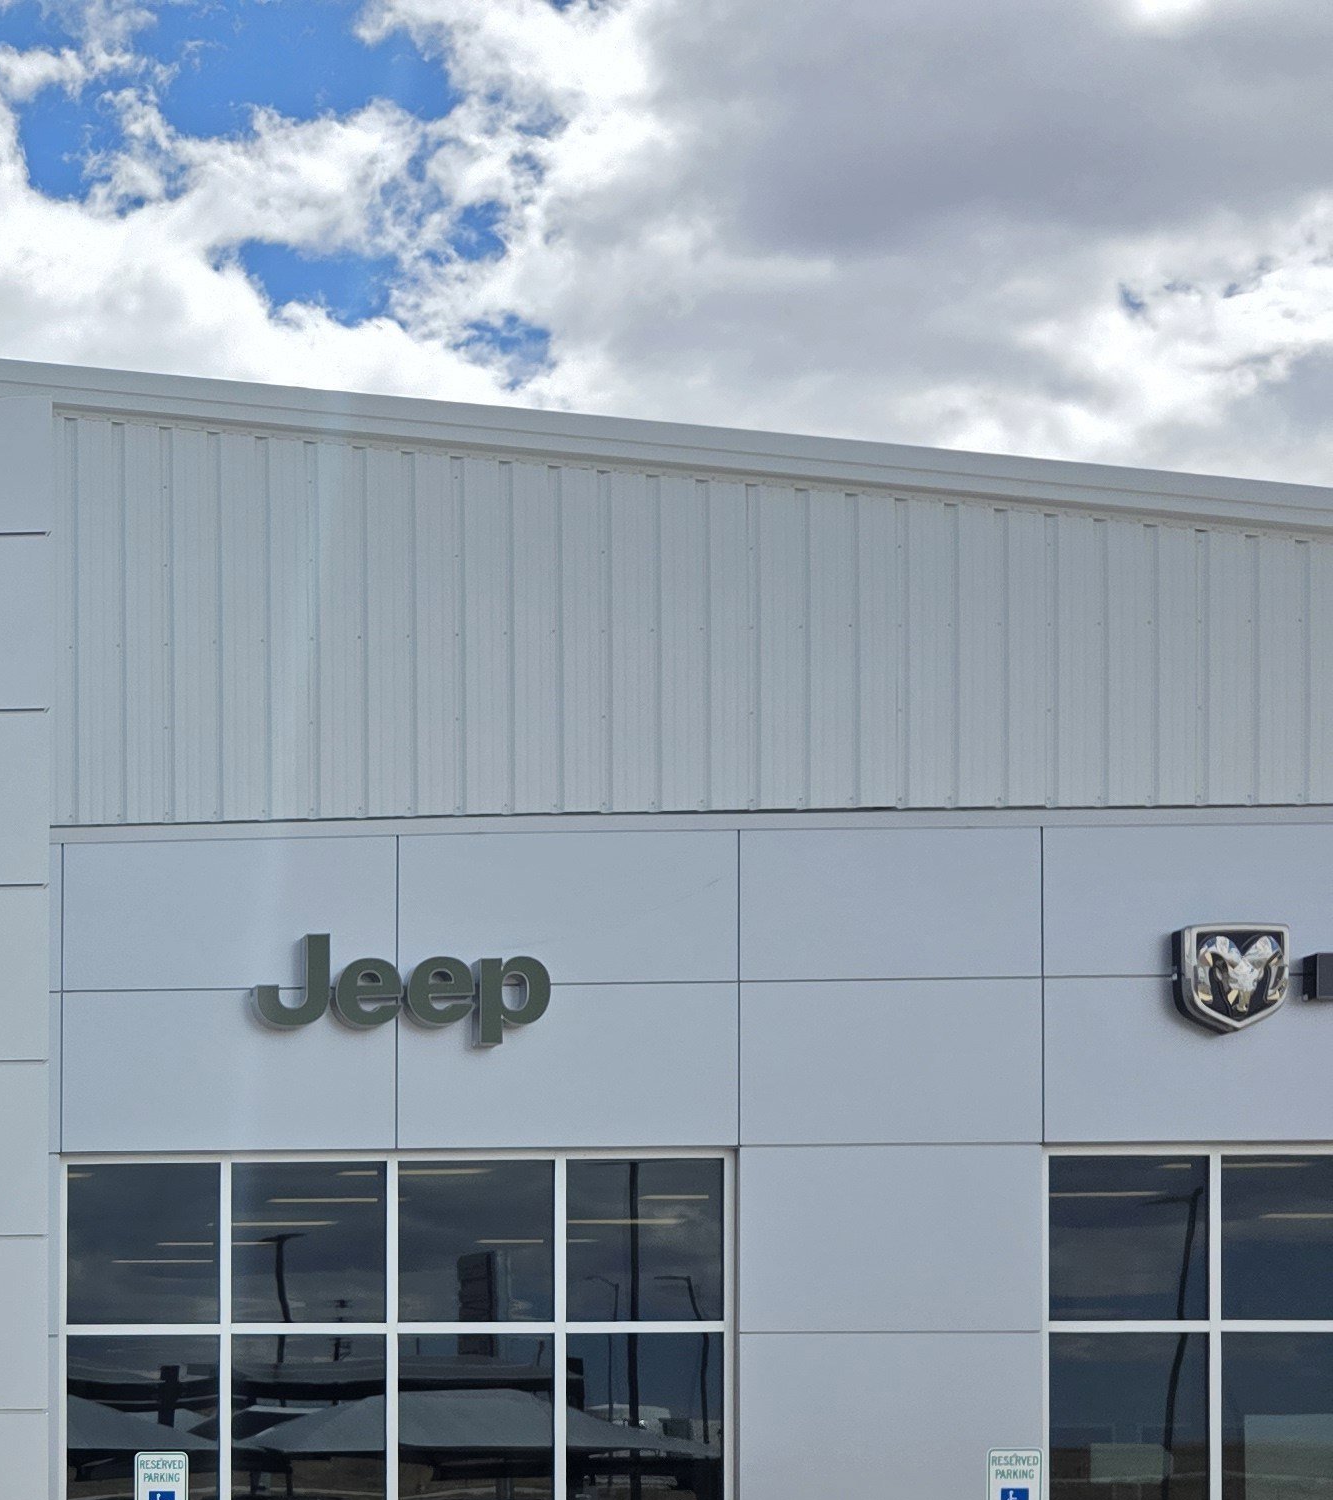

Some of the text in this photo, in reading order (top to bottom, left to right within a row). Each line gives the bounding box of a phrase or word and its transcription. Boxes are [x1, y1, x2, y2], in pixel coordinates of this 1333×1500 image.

[250, 933, 551, 1048] Jeep
[139, 1459, 184, 1470] RESERVED
[991, 1455, 1039, 1466] RESERVED
[143, 1472, 181, 1483] PARKING
[995, 1469, 1035, 1480] PARKING
